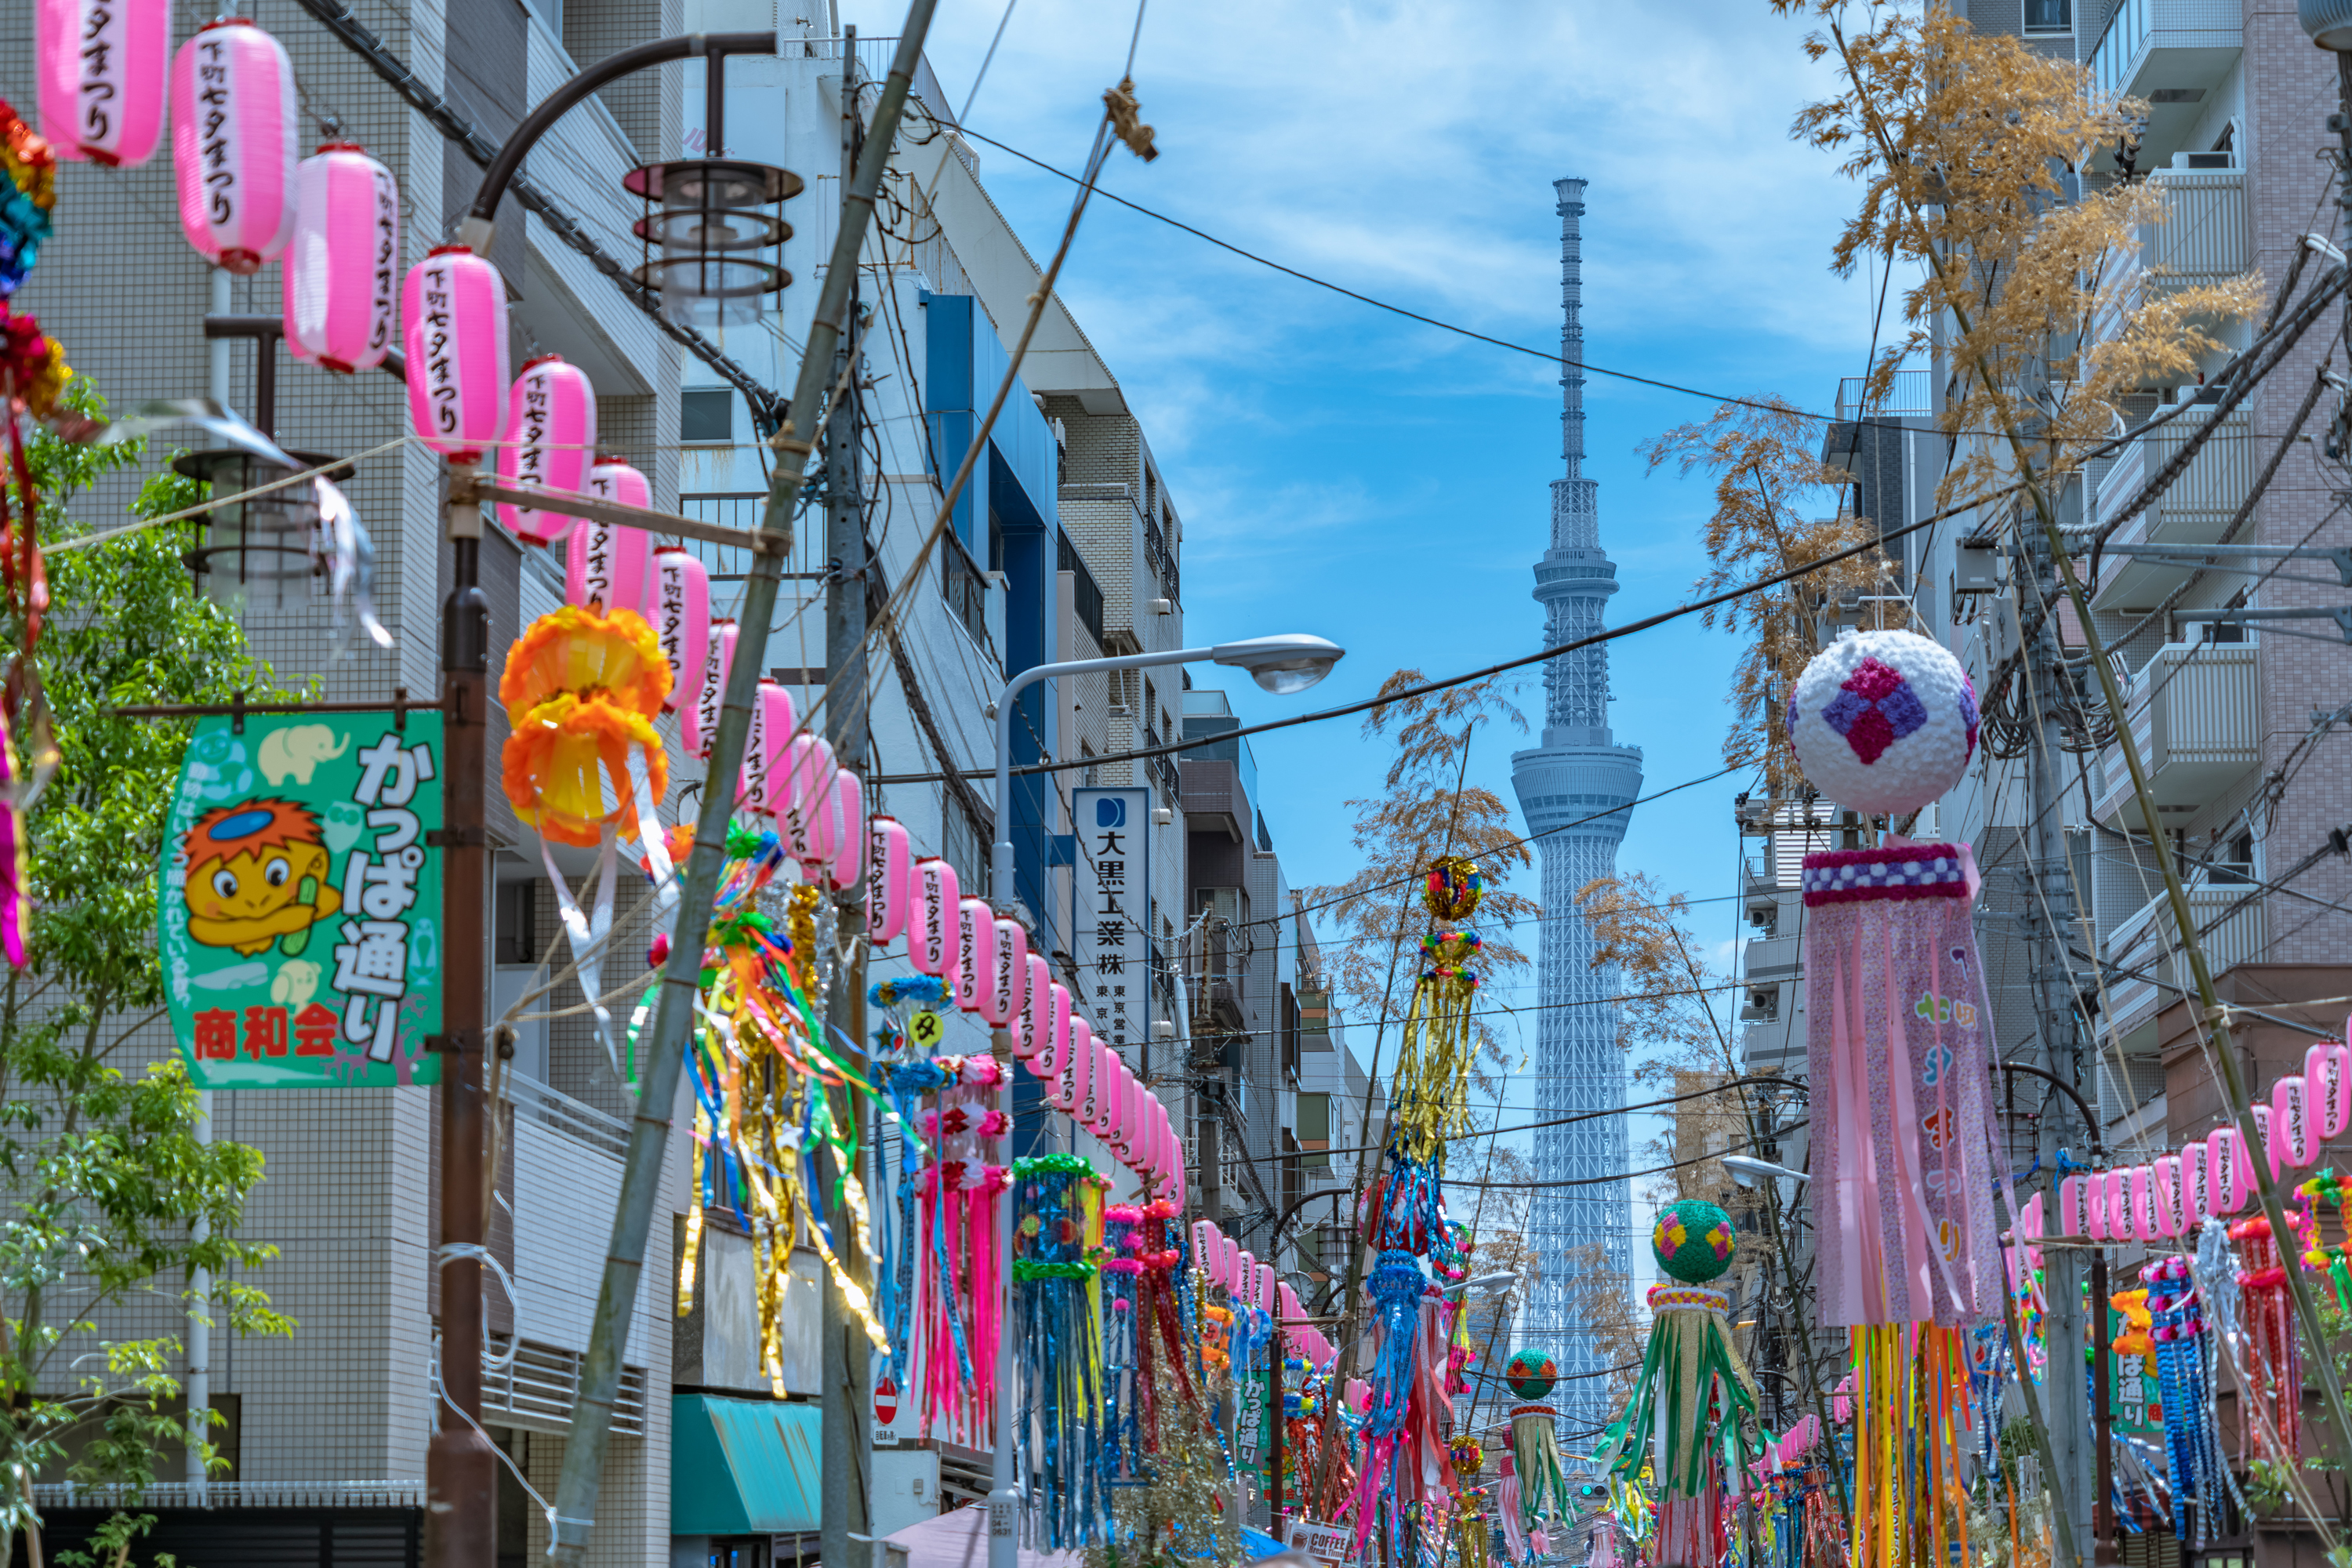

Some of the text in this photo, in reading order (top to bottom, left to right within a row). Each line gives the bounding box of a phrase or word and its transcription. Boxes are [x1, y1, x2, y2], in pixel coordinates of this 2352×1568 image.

[81, 0, 114, 140] 夕まつり
[200, 42, 233, 225] 下町七夕まつり
[426, 269, 456, 433] 下町七夕まつり
[519, 375, 546, 514] 下町七夕まつ
[662, 567, 683, 690] 下町七夕まつ
[332, 731, 436, 1063] かっぱ通り
[924, 870, 942, 963] 下町七夕まつり
[960, 910, 975, 998] 下町七夕まつり
[997, 929, 1013, 1013] 下町七夕まつり
[193, 1002, 339, 1061] 商和会
[2289, 1086, 2304, 1158] 下町七夕まつり
[2325, 1058, 2338, 1132] 下町七夕まつり
[2171, 1164, 2183, 1229] 下町七夕まつり
[2197, 1149, 2207, 1214] 下町七夕まつり
[2220, 1138, 2231, 1205] 下町七夕まつり
[1238, 1378, 1266, 1465] かっぱ通り
[1308, 1545, 1344, 1558] Break Time
[1311, 1533, 1346, 1551] COFFEE
